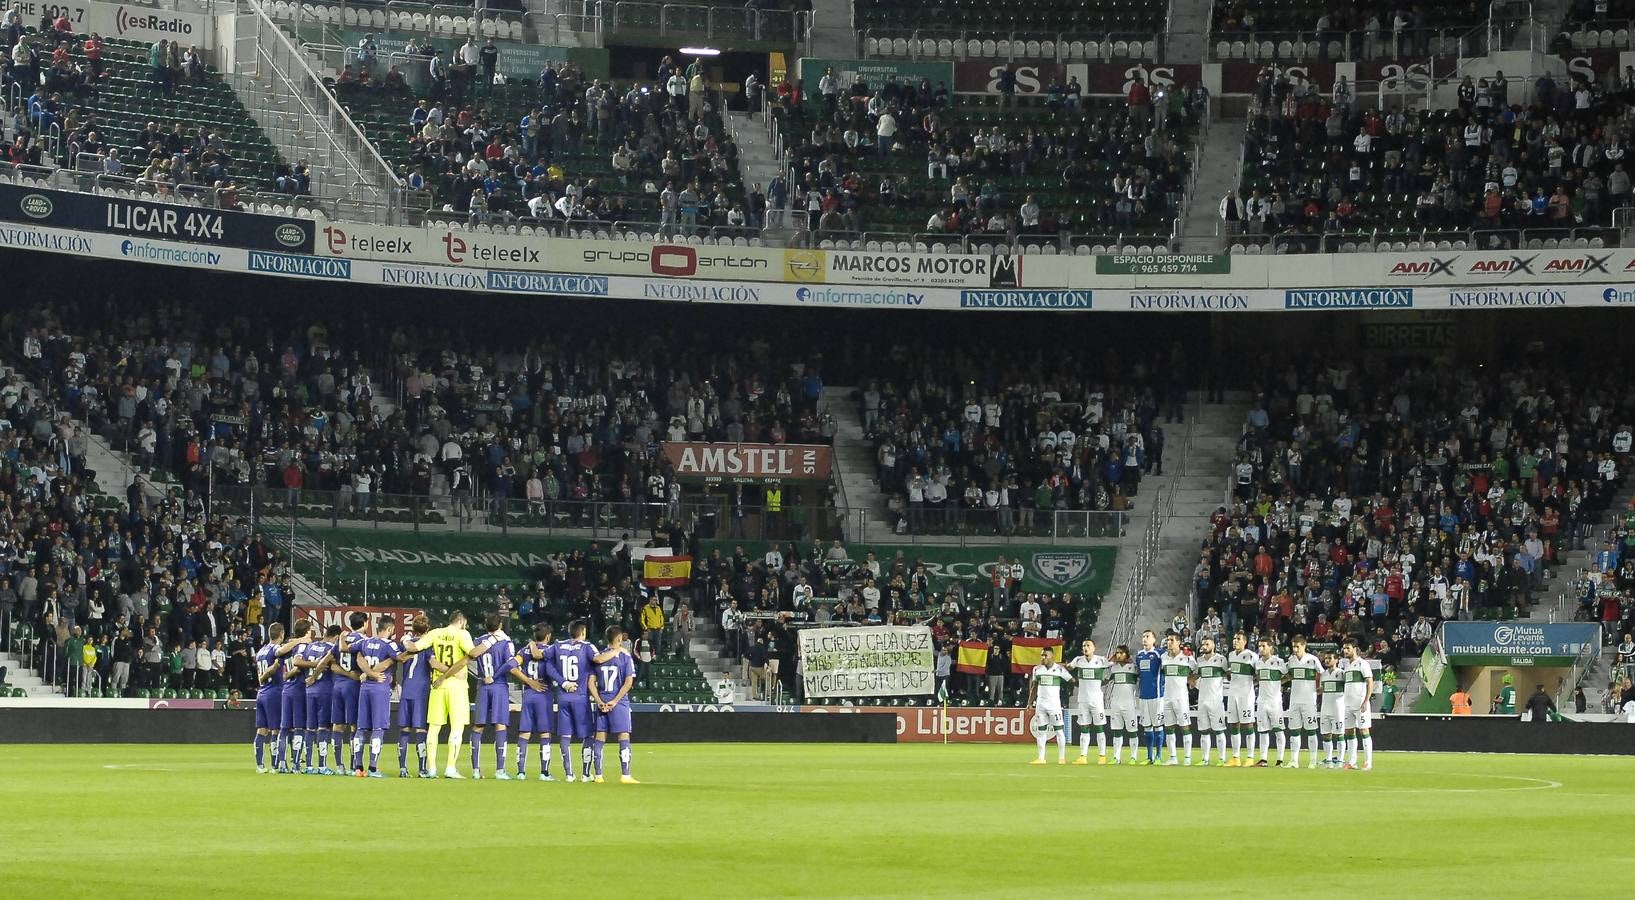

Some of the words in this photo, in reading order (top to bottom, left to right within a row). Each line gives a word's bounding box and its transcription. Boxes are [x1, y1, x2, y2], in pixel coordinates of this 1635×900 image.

[128, 15, 192, 35] esRadio
[987, 66, 1041, 93] as
[107, 203, 178, 235] ILICAR
[184, 213, 224, 240] 4X4
[0, 229, 93, 254] NFORMACIÓN
[351, 234, 412, 254] teleelx
[472, 243, 540, 263] teleelx
[583, 250, 650, 264] grupo
[698, 253, 768, 268] antón
[1113, 255, 1156, 264] ESPACIO
[1156, 255, 1213, 264] DISPONIBLE
[252, 251, 348, 278] INFORMACIÓN
[833, 254, 911, 273] MARCOS
[917, 257, 986, 275] MOTOR
[1141, 264, 1160, 273] 965
[1161, 264, 1178, 273] 459
[1179, 264, 1198, 273] 714
[382, 267, 486, 290] INFORMACIÓN
[490, 272, 605, 293] INFORMACIÓN
[644, 283, 761, 302] INFORMACIÓN
[965, 290, 1089, 308] INFORMACIÓN
[1130, 293, 1248, 309] INFORMACIÓN
[1290, 289, 1409, 307] INFORMACIÓN
[1450, 289, 1567, 307] INFORMACIÓN
[677, 447, 793, 474] AMSTEL
[803, 450, 816, 474] SIN
[1513, 633, 1545, 642] Levante
[1514, 626, 1543, 634] Mutua
[866, 632, 899, 651] CADA
[901, 633, 929, 651] VEZ
[1452, 643, 1552, 655] mutualevante.com
[482, 653, 495, 680] 8
[527, 661, 539, 680] 9
[560, 655, 579, 682] 16
[601, 666, 618, 692] 17
[858, 672, 896, 691] SOTO
[901, 671, 929, 689] DEP
[917, 709, 1025, 735] Libertad
[1218, 717, 1223, 725] 4
[1242, 710, 1252, 718] 22
[1307, 716, 1317, 724] 24
[1360, 716, 1366, 724] 5
